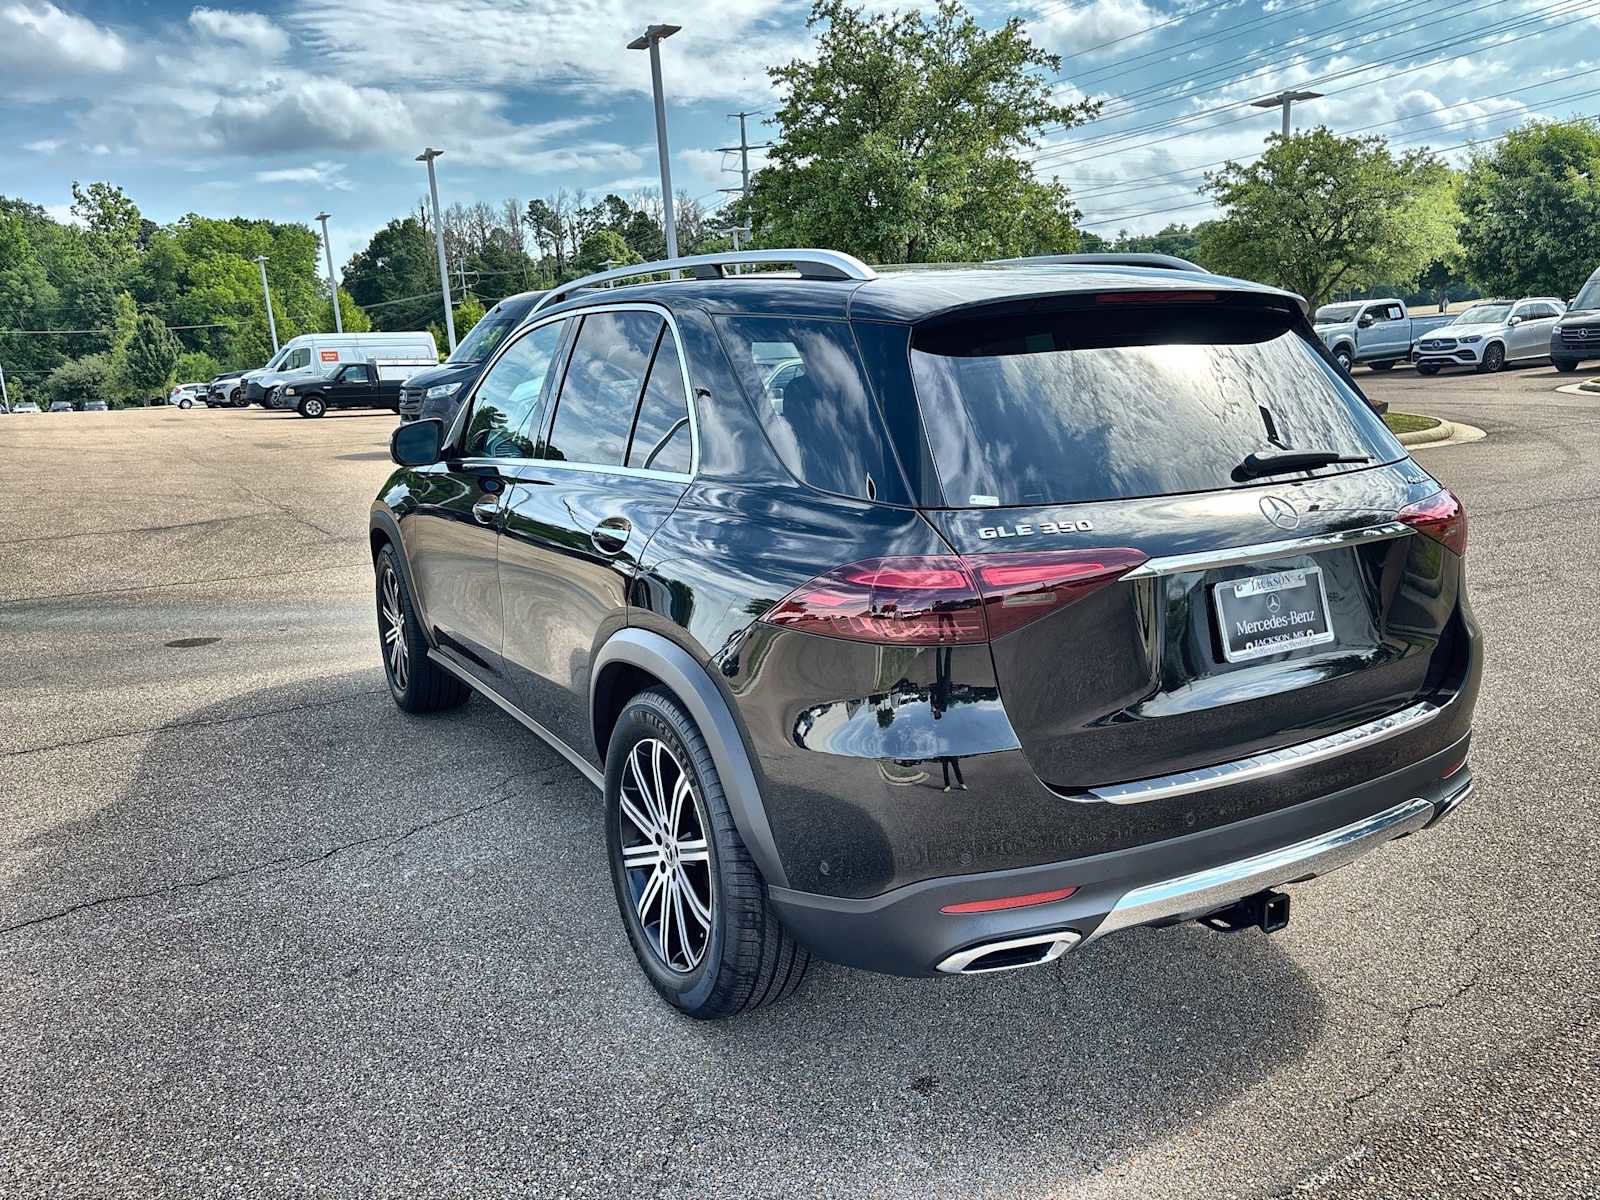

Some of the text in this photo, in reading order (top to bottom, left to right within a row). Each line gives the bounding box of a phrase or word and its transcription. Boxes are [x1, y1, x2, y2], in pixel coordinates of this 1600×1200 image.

[978, 519, 1094, 540] GLE 350
[1251, 574, 1291, 592] JACKSON
[1236, 611, 1315, 636] Mercedes-Benz
